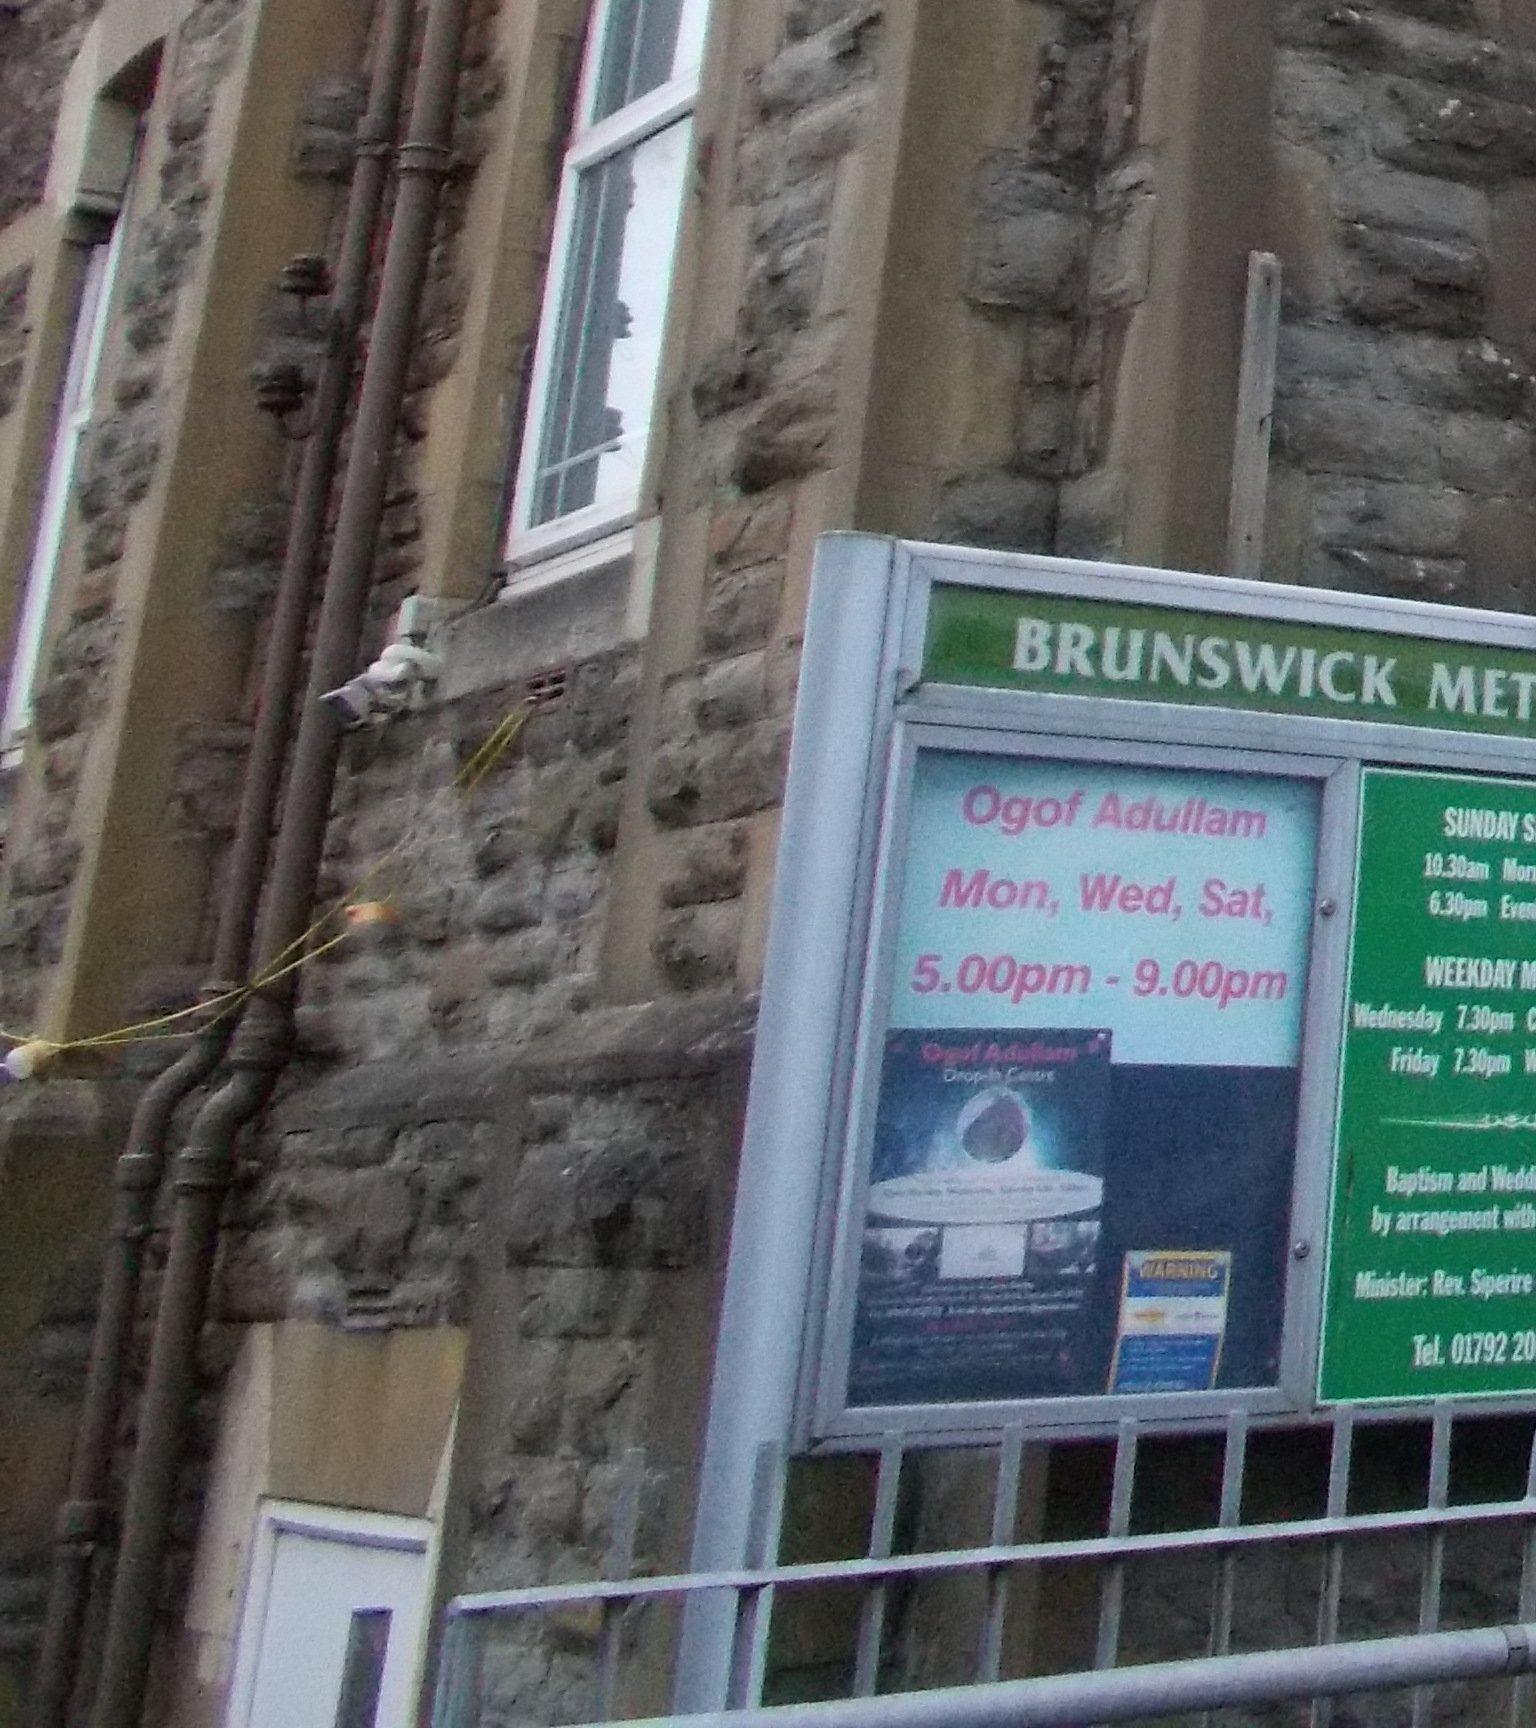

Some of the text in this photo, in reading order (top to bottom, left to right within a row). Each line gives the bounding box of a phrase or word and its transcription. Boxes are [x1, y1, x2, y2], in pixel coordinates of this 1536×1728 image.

[1012, 615, 1397, 706] BRUNSWICK
[962, 784, 1267, 838] Ogof Adullam
[1444, 805, 1519, 841] SUNDAY
[1424, 851, 1490, 881] 10.30am
[939, 868, 1274, 927] Mon, Wed, Sat,
[1428, 889, 1488, 920] 6.30pm
[911, 954, 1288, 1010] 5.00pm - 9.00pm
[1424, 955, 1517, 989] WEEKDAY
[1353, 1002, 1444, 1035] Wednesday
[1456, 1004, 1514, 1034] 7.30pm
[1390, 1047, 1441, 1078] Friday
[1454, 1047, 1511, 1078] 7.30pm
[1386, 1166, 1454, 1198] Baptism
[1457, 1165, 1489, 1191] and
[1371, 1205, 1393, 1237] by
[1395, 1205, 1500, 1235] arrangement
[1502, 1202, 1536, 1229] with
[1354, 1270, 1429, 1299] Minister:
[1432, 1269, 1467, 1297] Rev.
[1413, 1334, 1446, 1367] Tel.
[1451, 1330, 1508, 1365] 01792
